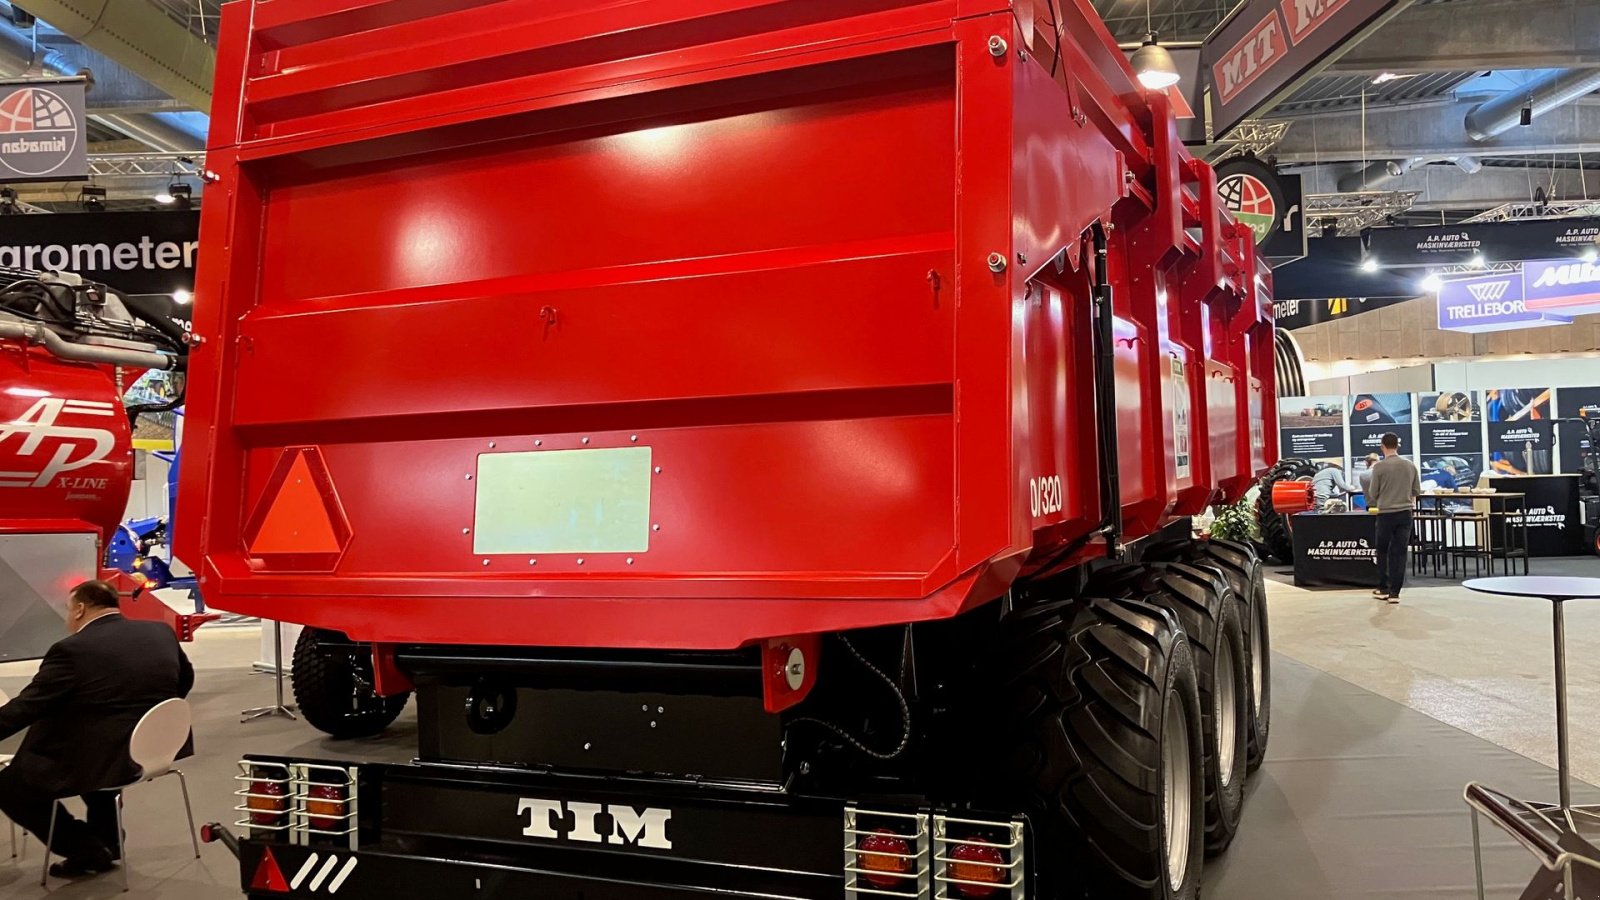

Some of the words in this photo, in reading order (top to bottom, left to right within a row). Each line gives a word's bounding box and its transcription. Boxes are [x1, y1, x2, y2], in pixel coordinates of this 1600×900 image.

[56, 477, 109, 489] X-LINE
[1030, 475, 1062, 518] 0/320
[1528, 507, 1546, 515] AUTO
[516, 797, 673, 850] TIM
